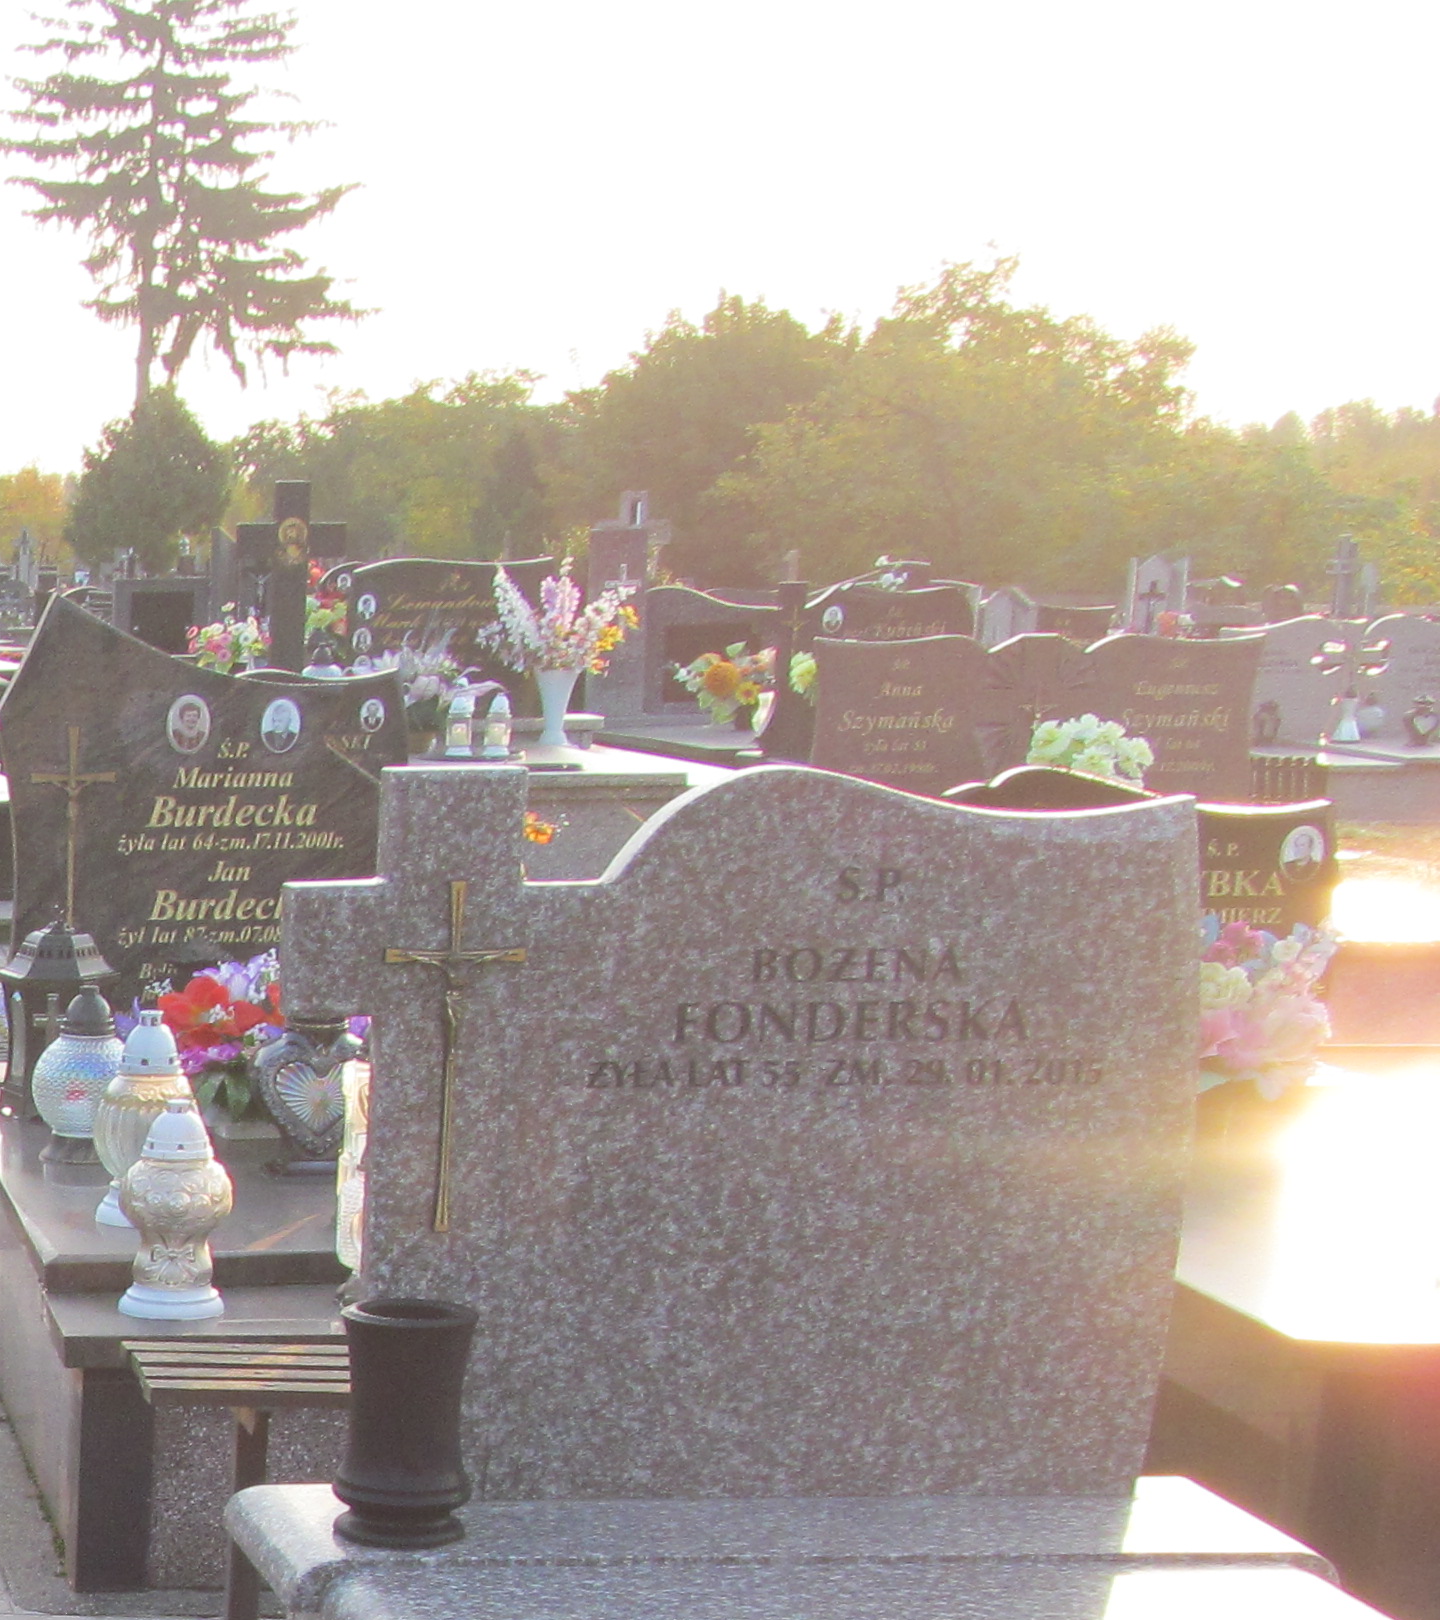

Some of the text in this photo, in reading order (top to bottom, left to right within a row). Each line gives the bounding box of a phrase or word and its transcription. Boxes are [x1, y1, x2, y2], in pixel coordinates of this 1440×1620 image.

[217, 738, 249, 759] Ś.P.
[172, 767, 294, 789] Marianna
[145, 795, 319, 828] Burdecka
[162, 834, 187, 850] lat
[208, 861, 251, 882] Jan
[1202, 870, 1286, 897] BKA
[151, 927, 177, 944] lat
[673, 1000, 1029, 1044] FONDERSKA
